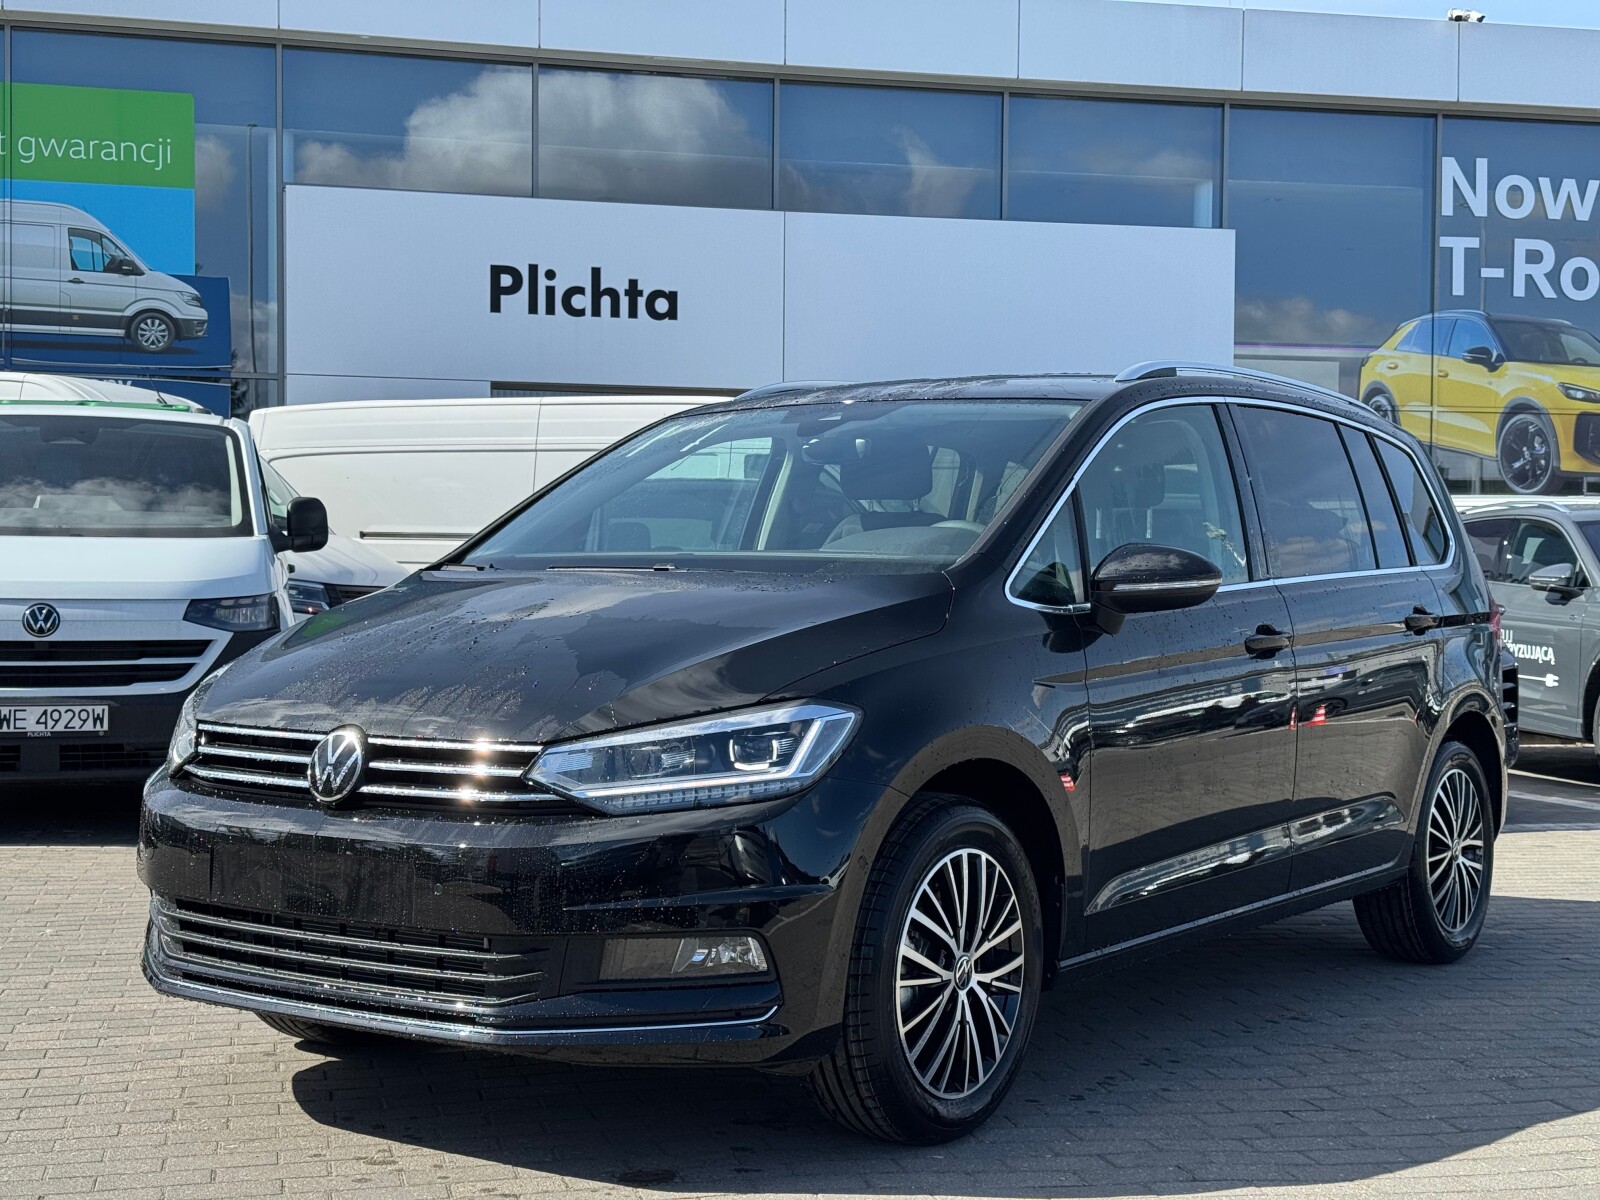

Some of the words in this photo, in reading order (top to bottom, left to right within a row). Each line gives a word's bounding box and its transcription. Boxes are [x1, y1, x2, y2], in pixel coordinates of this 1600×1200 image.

[18, 136, 171, 170] gwarancji
[1441, 156, 1600, 222] Now
[490, 263, 678, 321] Plichta
[1439, 236, 1600, 301] T-Ro
[0, 708, 27, 730] WE
[35, 708, 105, 729] 4929W
